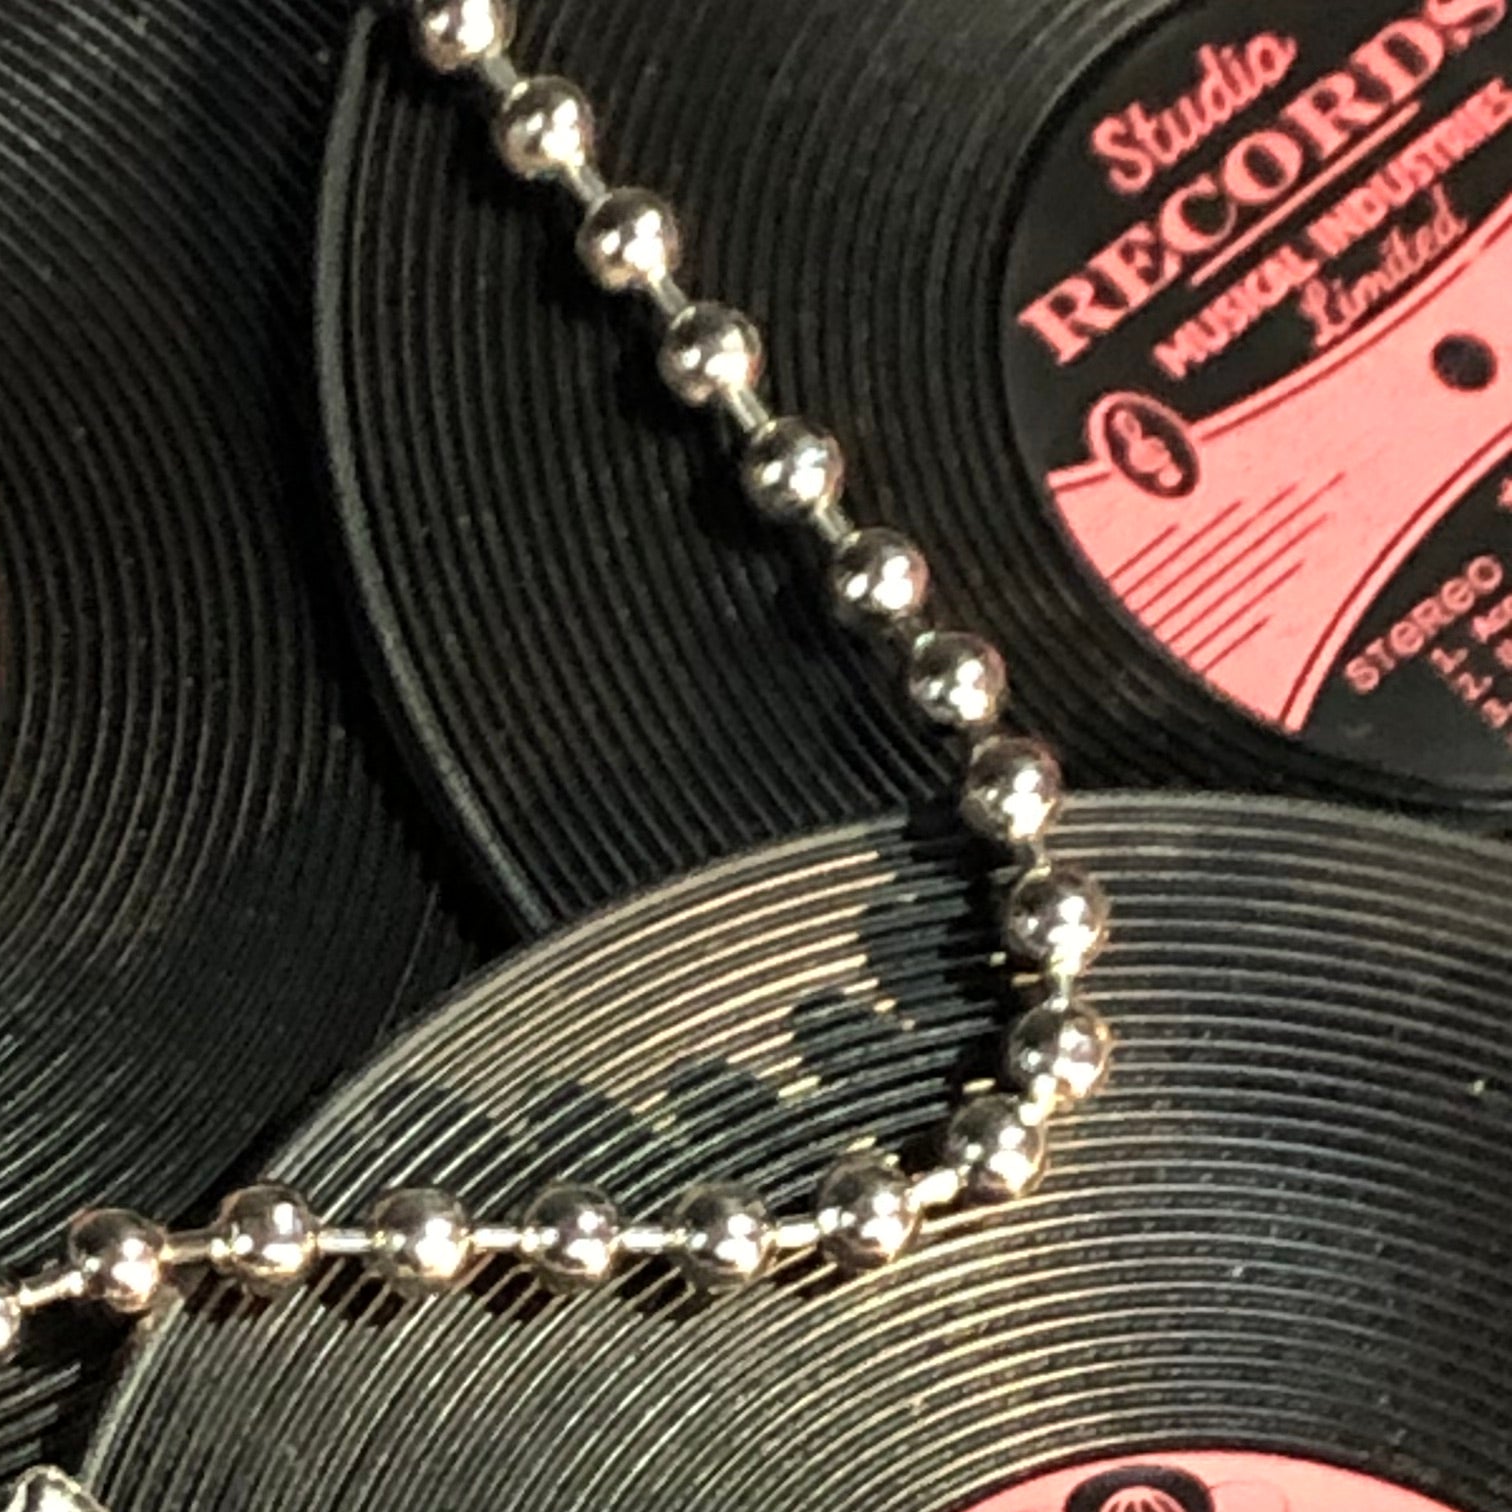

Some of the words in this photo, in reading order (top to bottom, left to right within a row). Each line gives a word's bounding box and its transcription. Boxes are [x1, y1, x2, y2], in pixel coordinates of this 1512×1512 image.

[1017, 0, 1506, 364] RECORDS
[1091, 29, 1298, 193] Studio
[1154, 247, 1319, 379] MUSICAL
[1300, 183, 1467, 347] Limited
